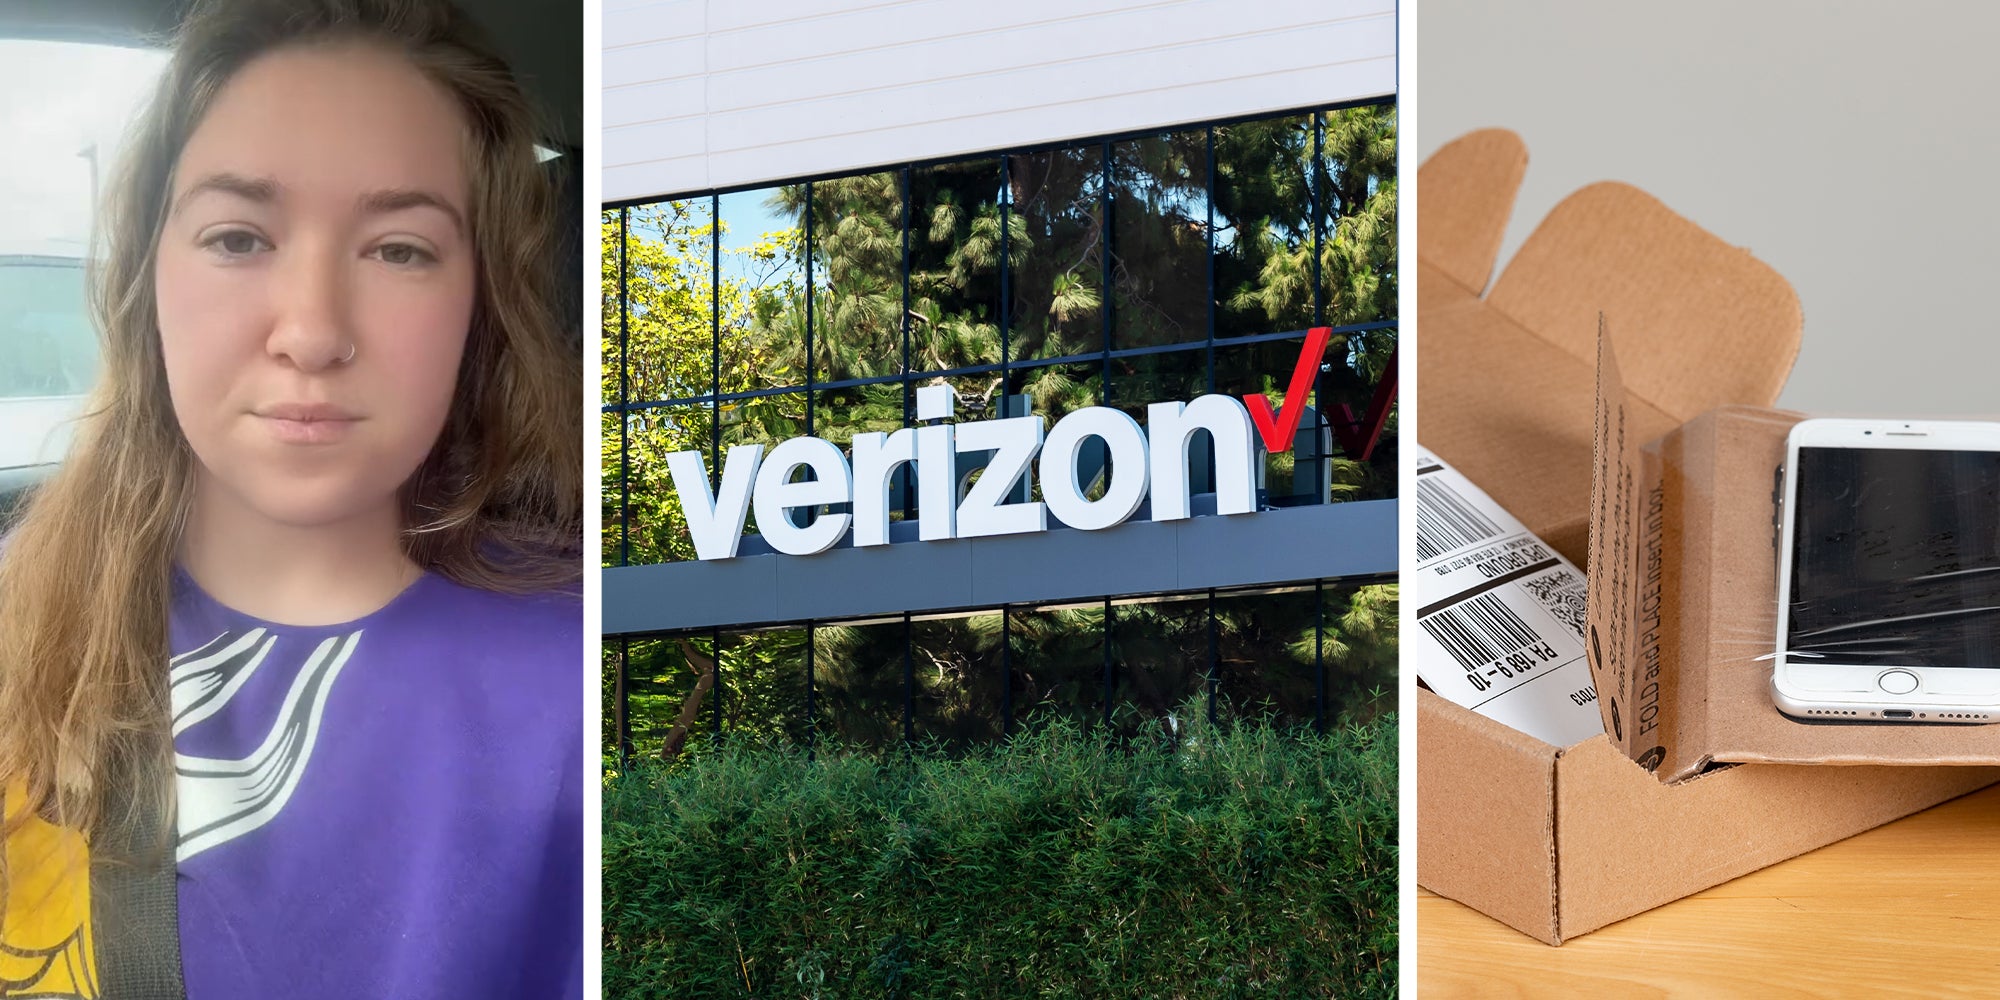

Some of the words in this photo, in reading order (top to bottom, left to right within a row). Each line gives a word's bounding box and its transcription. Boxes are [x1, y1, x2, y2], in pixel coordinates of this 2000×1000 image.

[667, 384, 1257, 561] verizon
[1645, 515, 1662, 538] in
[1476, 551, 1528, 578] GROUND
[1521, 544, 1551, 566] UPS
[1645, 534, 1662, 588] insert
[1641, 585, 1662, 648] PLACE
[1505, 651, 1537, 673] 168
[1529, 641, 1558, 662] PA
[1643, 645, 1661, 683] and
[1640, 682, 1660, 736] FOLD
